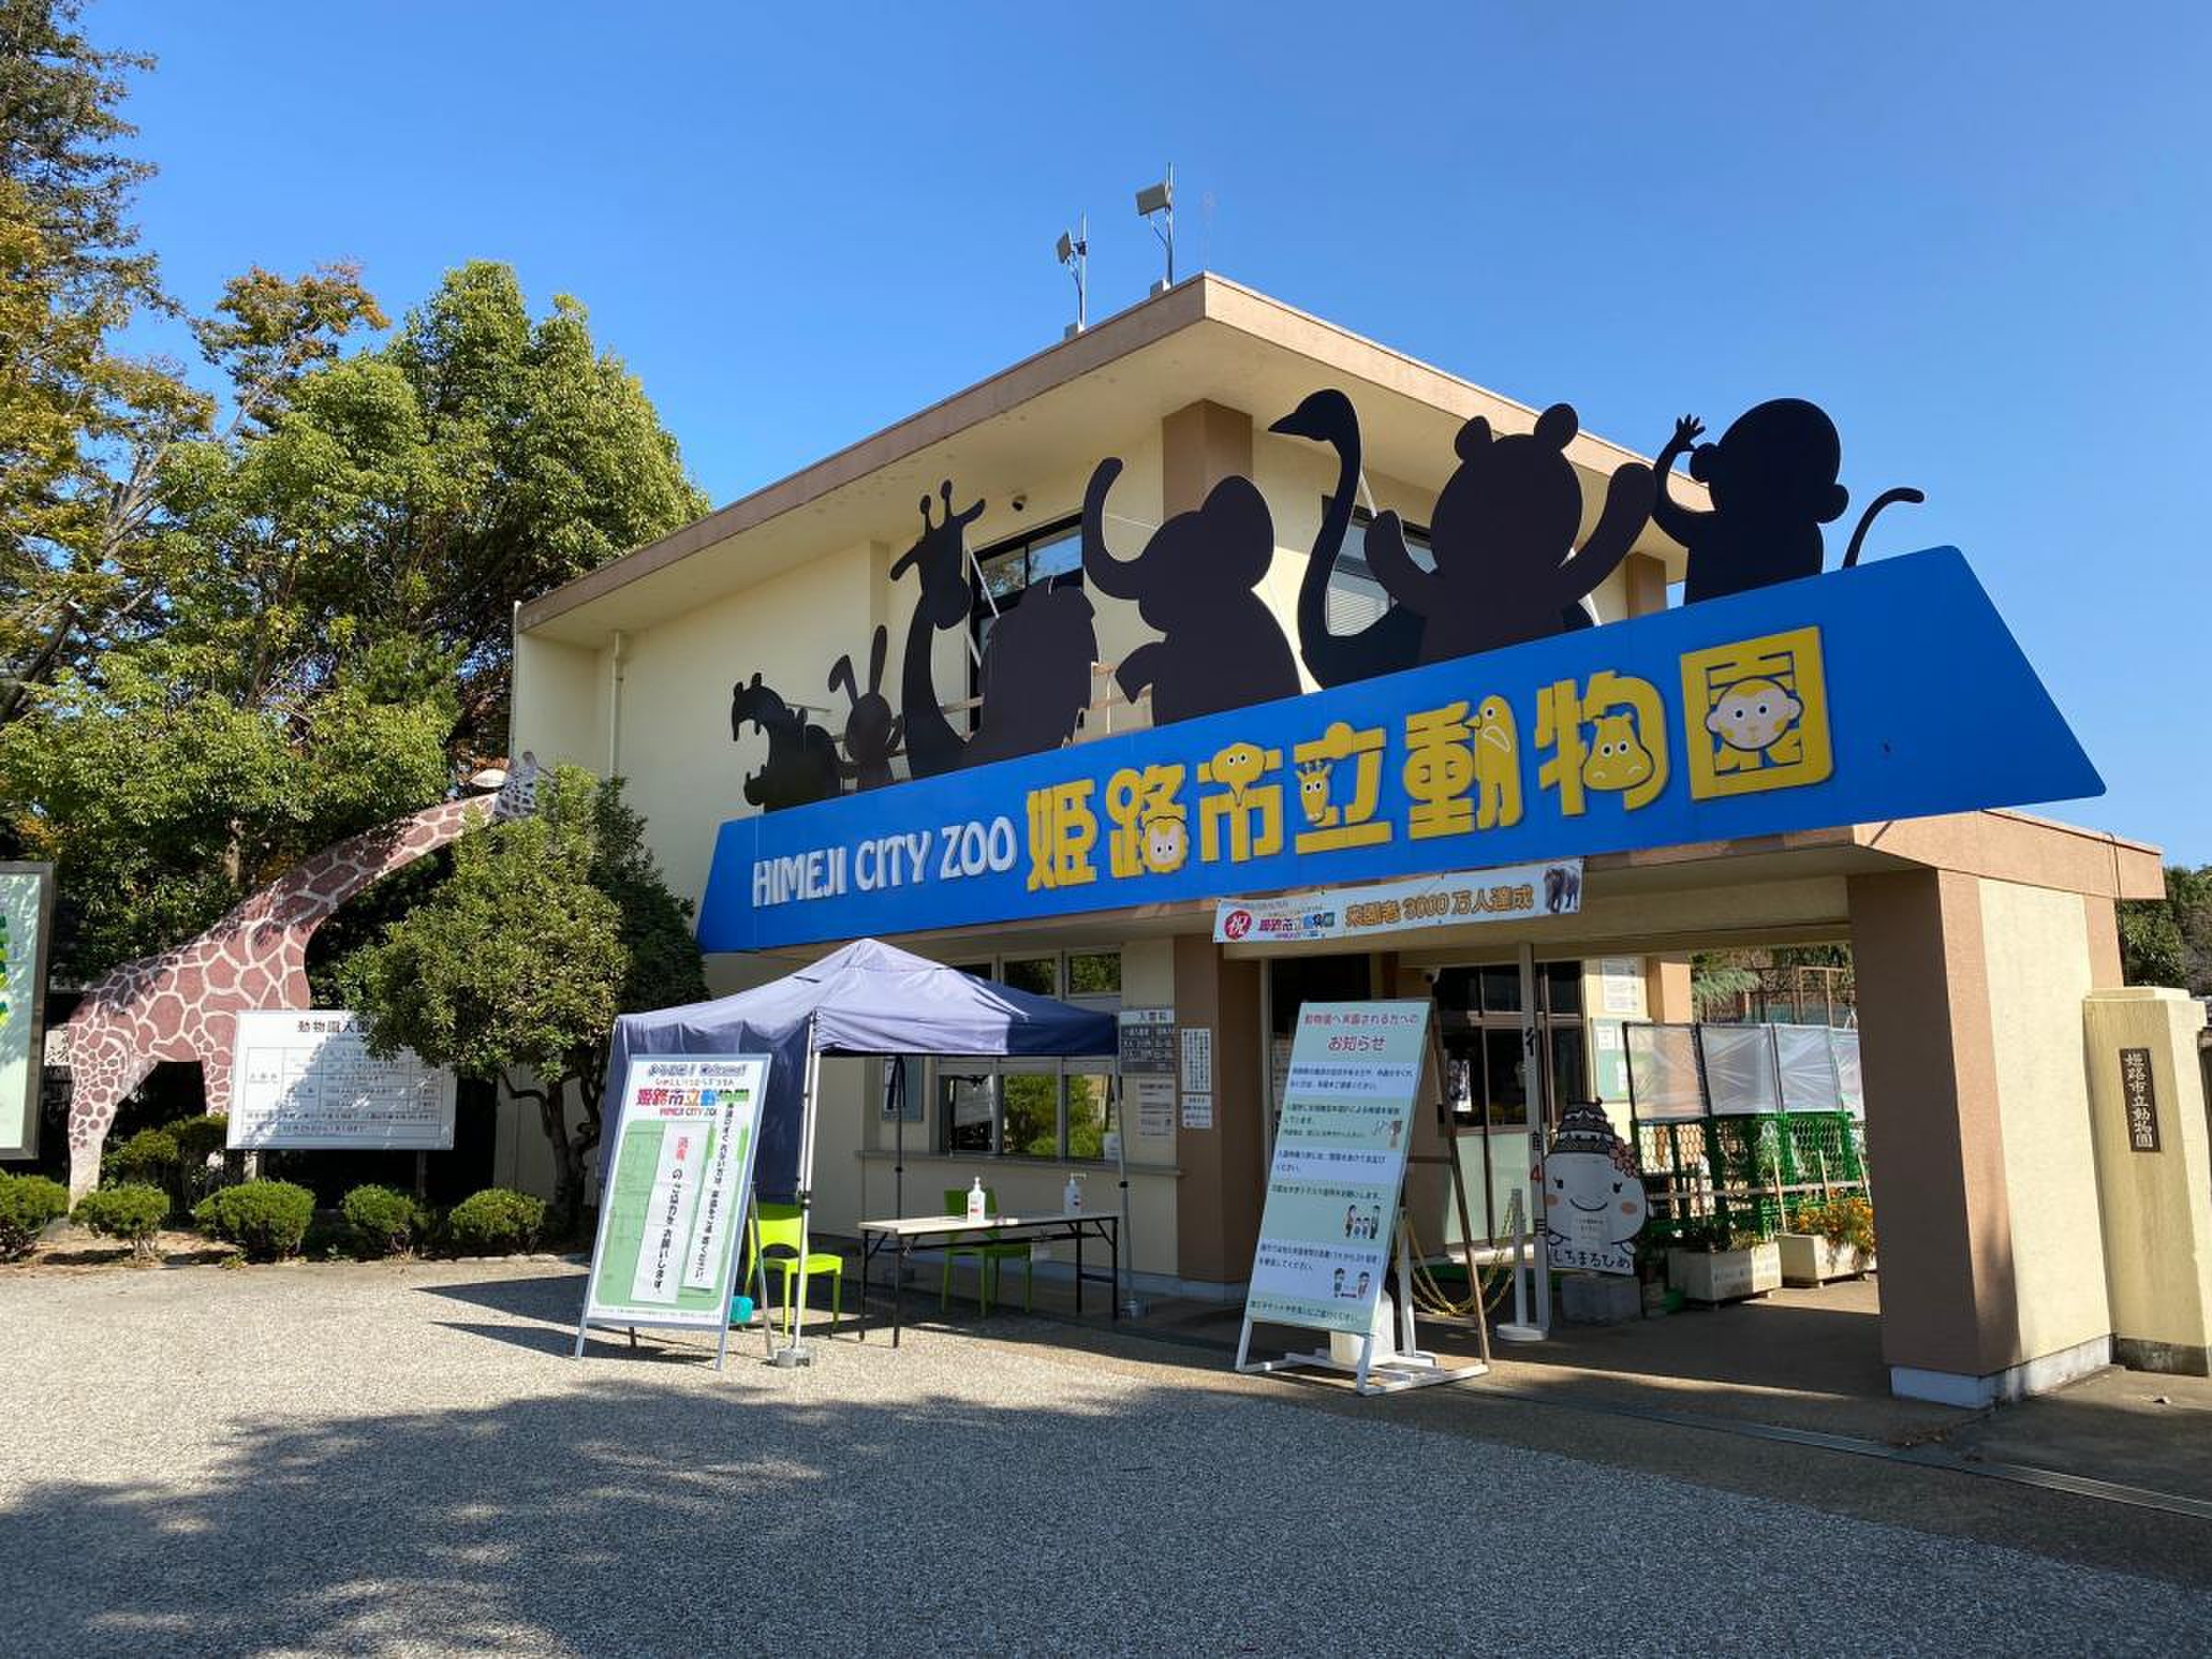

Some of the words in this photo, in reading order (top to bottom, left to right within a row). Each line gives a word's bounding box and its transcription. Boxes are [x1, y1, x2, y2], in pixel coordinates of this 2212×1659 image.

[1027, 625, 1835, 891] 姫路市立動物園
[752, 843, 848, 908] HIMEJI
[854, 830, 933, 892] CITY
[940, 816, 1018, 879] ZOO
[1327, 1034, 1386, 1052] お知らせ
[1553, 1250, 1630, 1269] しろまるひめ
